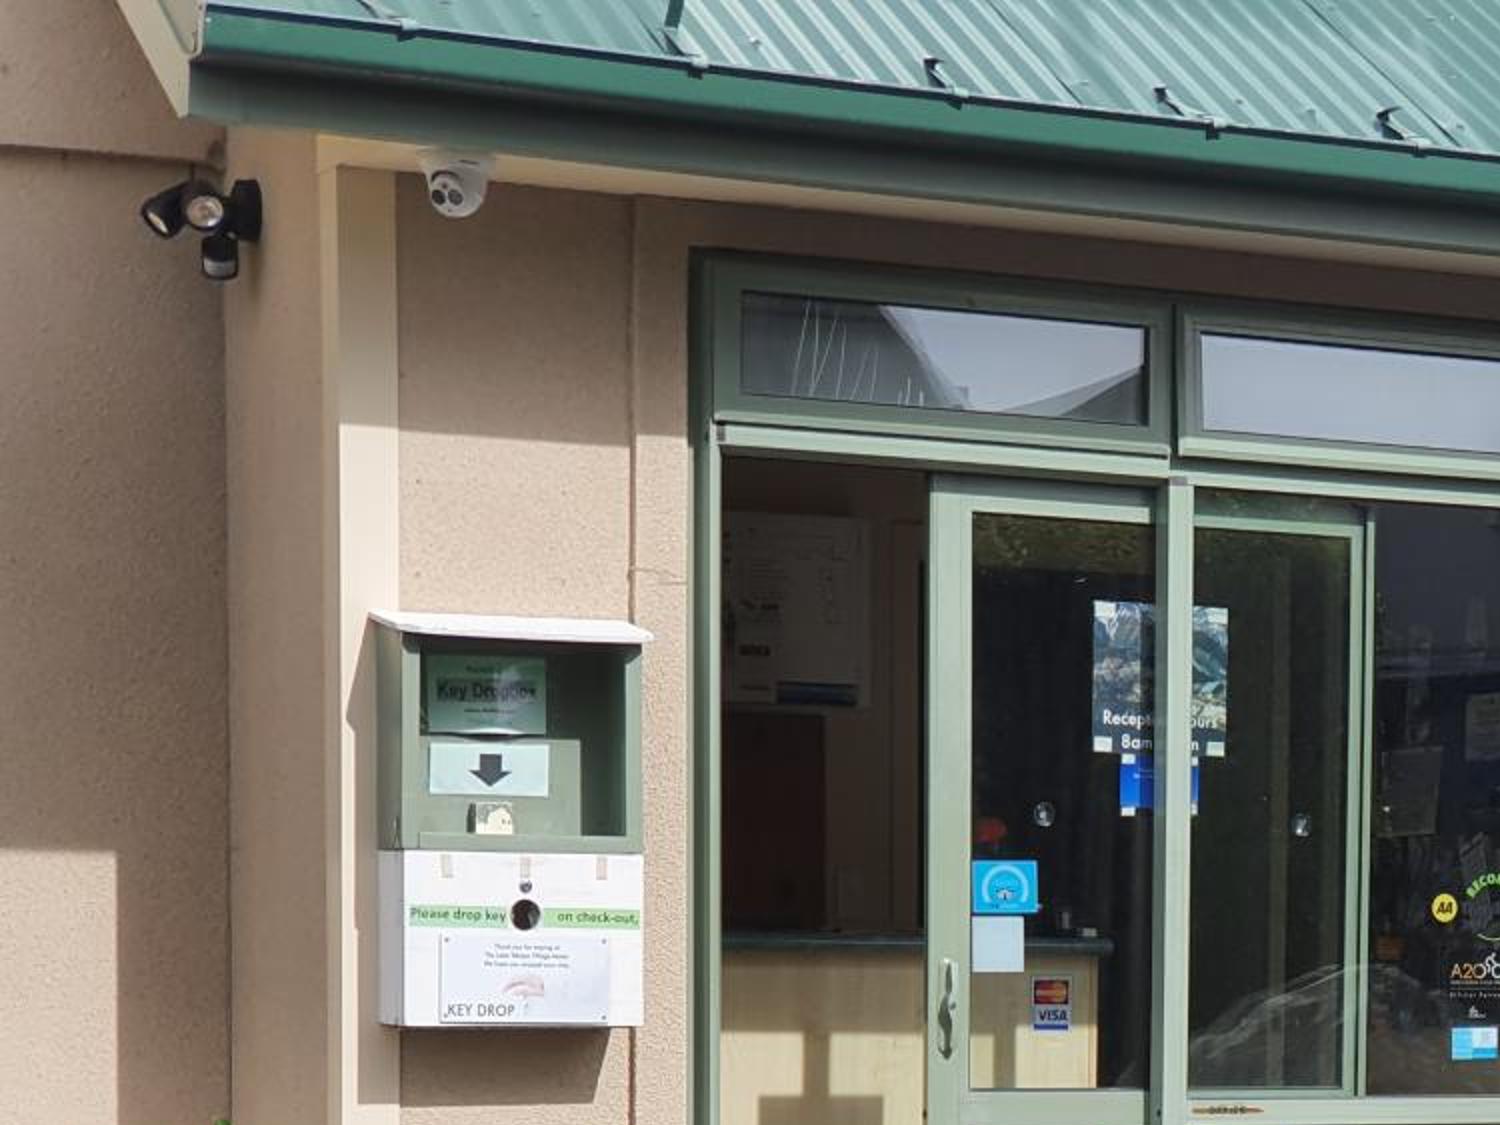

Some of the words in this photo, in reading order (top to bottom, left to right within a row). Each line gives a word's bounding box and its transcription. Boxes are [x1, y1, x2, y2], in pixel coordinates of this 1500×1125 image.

[410, 906, 449, 922] Please
[453, 907, 480, 922] drop
[485, 909, 507, 923] key
[557, 911, 573, 922] on
[1437, 902, 1454, 914] AA
[447, 1003, 473, 1017] KEY
[477, 1003, 515, 1017] DROP
[1039, 1008, 1068, 1021] VISA
